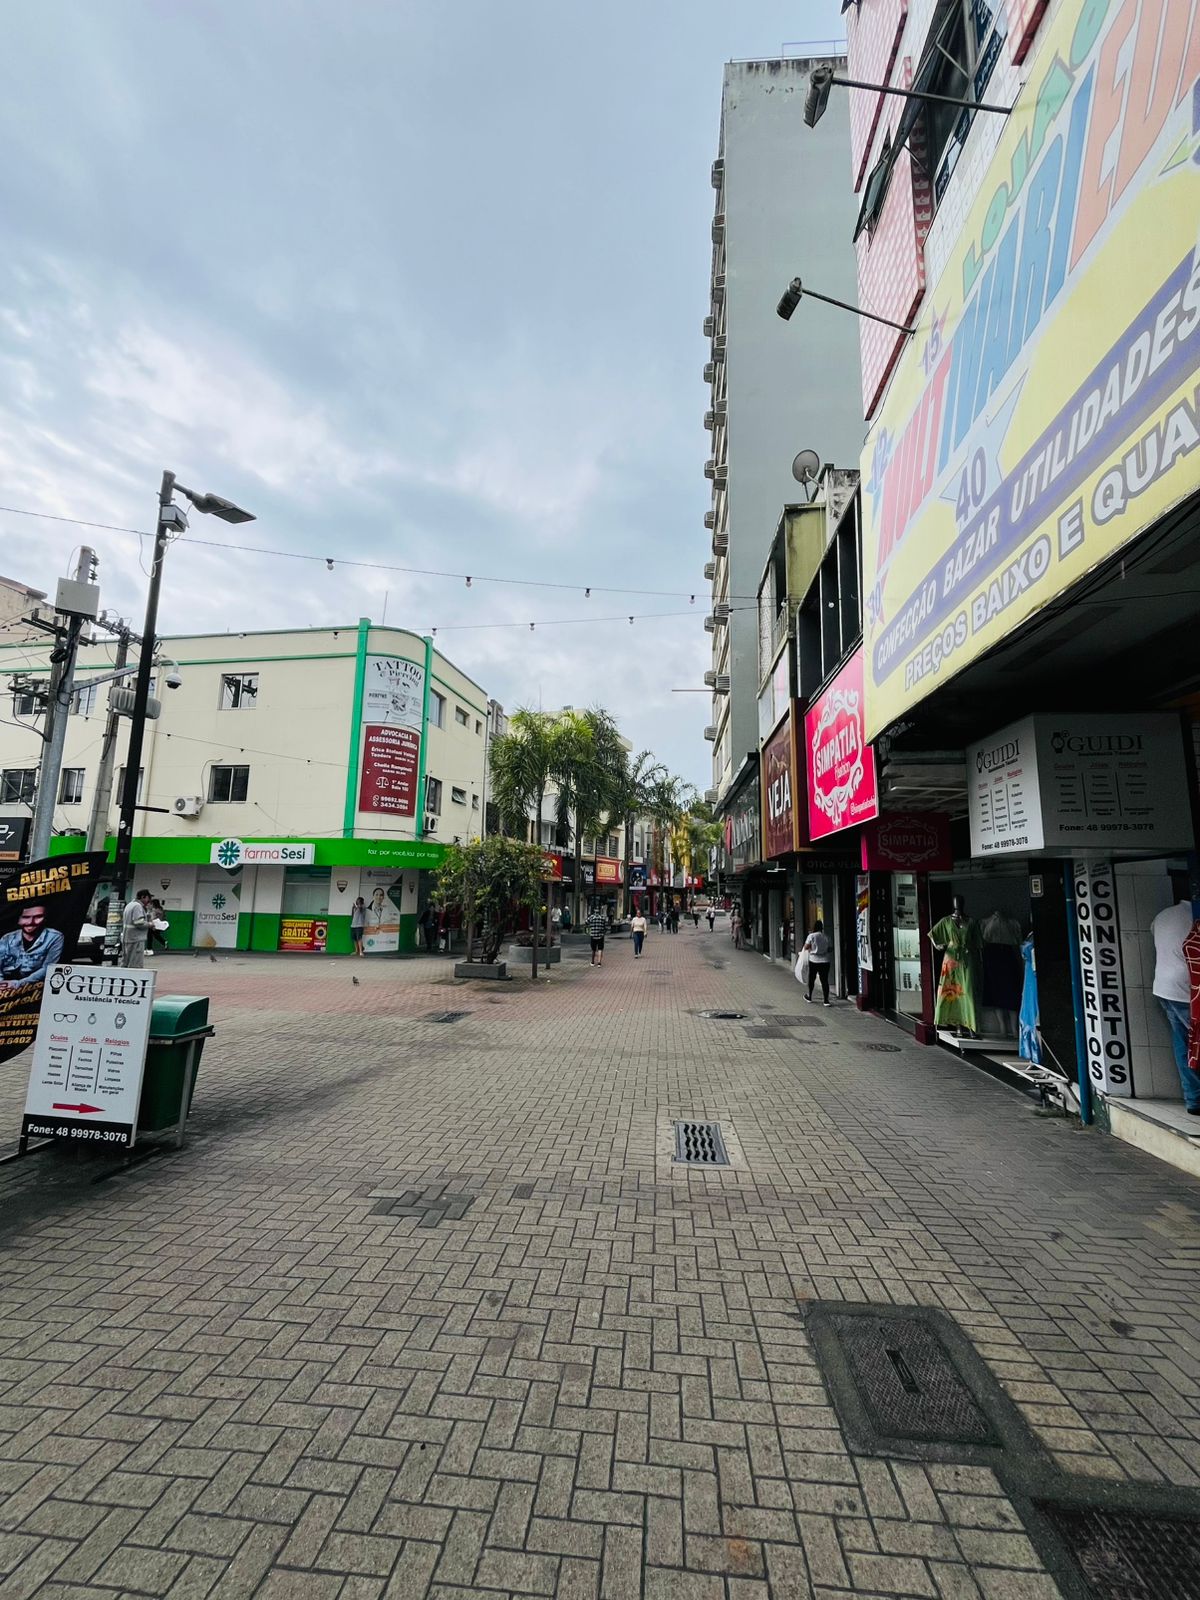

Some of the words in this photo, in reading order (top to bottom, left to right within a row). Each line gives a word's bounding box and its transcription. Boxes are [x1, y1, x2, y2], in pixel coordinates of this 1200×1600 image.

[876, 0, 1200, 575] MULTIVARIED
[917, 317, 940, 377] 15
[877, 579, 937, 670] CONFECÇÃO
[943, 504, 1000, 598] BAZAR
[1010, 266, 1200, 524] UTILIDADES
[956, 446, 987, 522] 40
[905, 611, 967, 692] PREÇOS
[972, 533, 1052, 636] BAIXO
[1059, 499, 1084, 560] E
[1091, 398, 1200, 525] QUA
[373, 660, 421, 681] TATTOO
[368, 736, 400, 746] ASSESSORIA
[381, 729, 409, 740] ADVOCACIA
[1067, 735, 1144, 751] GUIDI
[816, 720, 857, 778] SIMPATIA
[984, 739, 1020, 769] GUIDI
[768, 769, 791, 821] VEJA
[1059, 824, 1084, 832] Fone:
[1086, 824, 1097, 832] 48
[882, 834, 935, 847] SIMPATIA
[20, 865, 69, 885] AULAS
[71, 862, 89, 876] DE
[6, 878, 71, 901] BATERIA
[66, 975, 149, 998] GUIDI
[1076, 880, 1103, 1080] CONSERTOS
[1092, 880, 1127, 1084] CONSERTOS
[75, 995, 112, 1003] Assistência
[27, 1123, 54, 1134] Fone:
[56, 1127, 69, 1137] 48
[70, 1128, 128, 1143] 99978-3078
